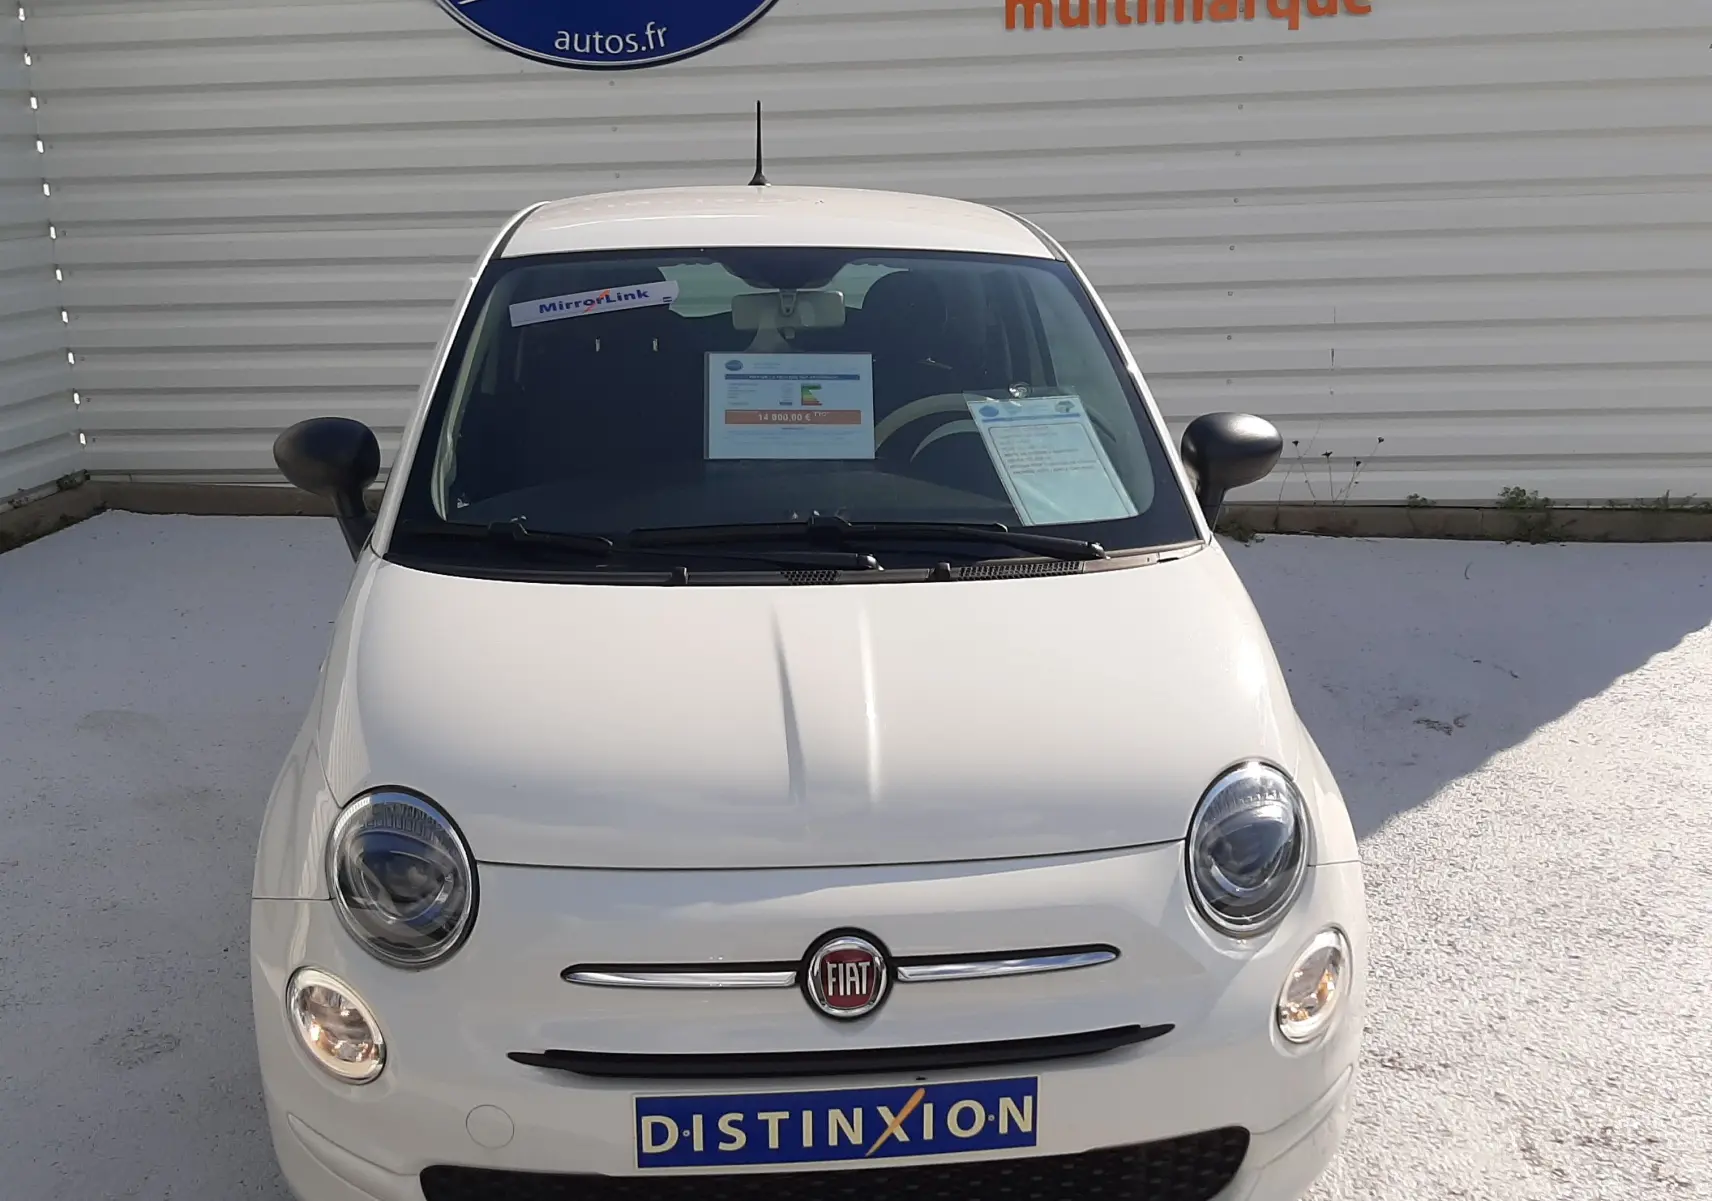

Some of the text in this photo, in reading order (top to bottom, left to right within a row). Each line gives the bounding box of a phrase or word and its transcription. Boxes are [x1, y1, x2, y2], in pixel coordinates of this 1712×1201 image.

[554, 22, 667, 54] autos.fr
[539, 289, 649, 314] MirrorLink
[827, 961, 871, 996] FIAT
[641, 1089, 1034, 1157] DISTINXION
